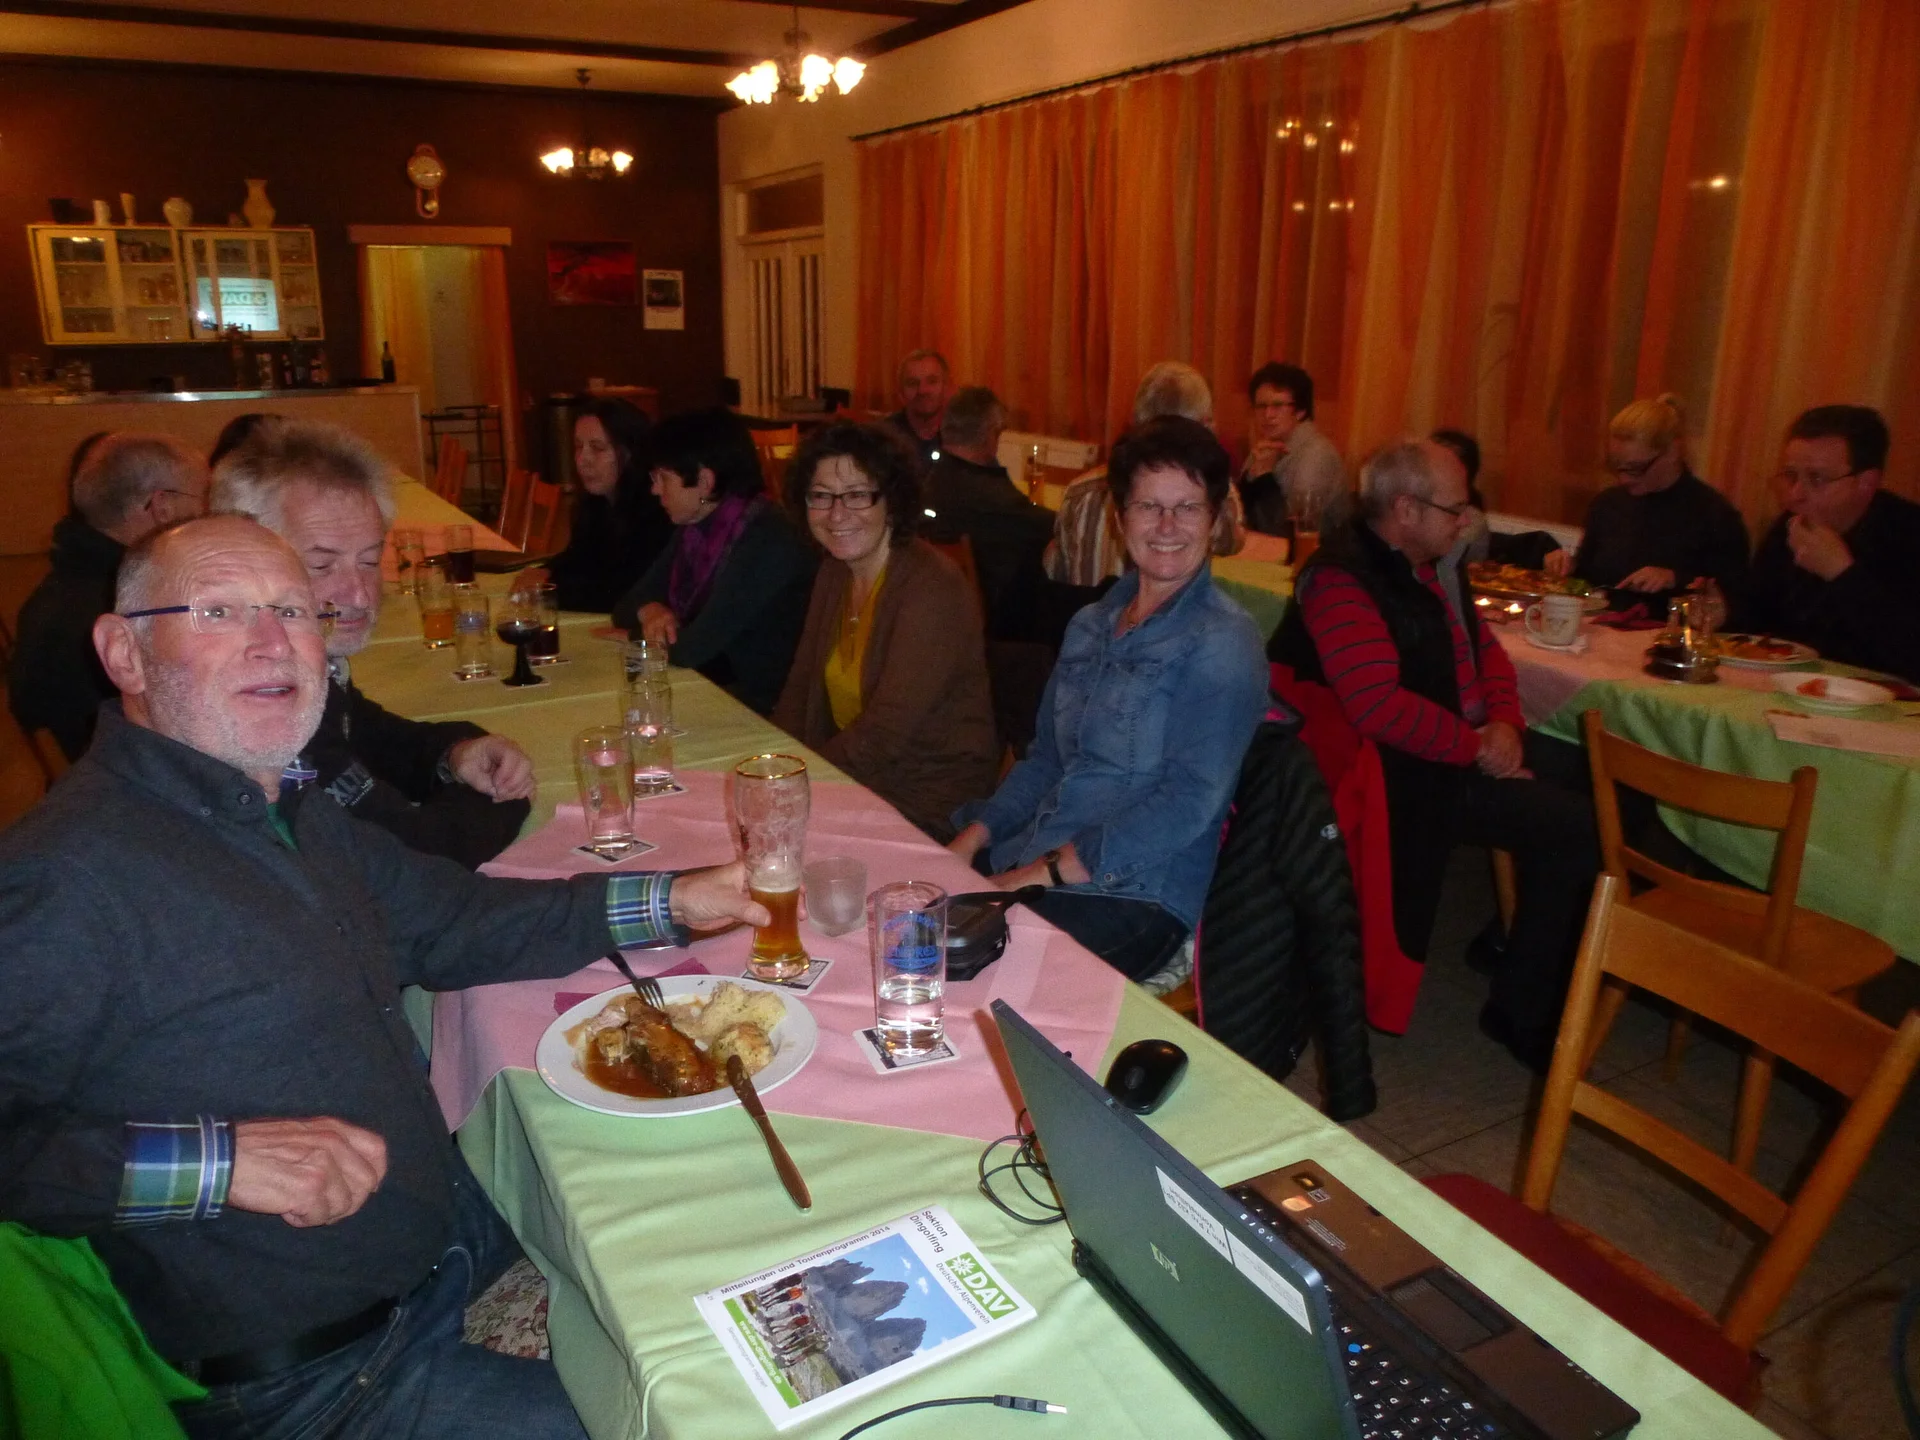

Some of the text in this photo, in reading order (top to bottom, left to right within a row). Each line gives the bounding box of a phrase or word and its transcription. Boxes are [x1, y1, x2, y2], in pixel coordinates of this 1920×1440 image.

[909, 1215, 945, 1253] Dingolfing
[922, 1210, 948, 1238] Sektion
[720, 1269, 777, 1295] Mitteilungen
[777, 1262, 796, 1273] und
[797, 1234, 870, 1265] Tourenprogramm
[869, 1225, 891, 1238] 2014
[936, 1262, 990, 1325] Deutscher Alpenverein
[963, 1271, 1016, 1312] DAV
